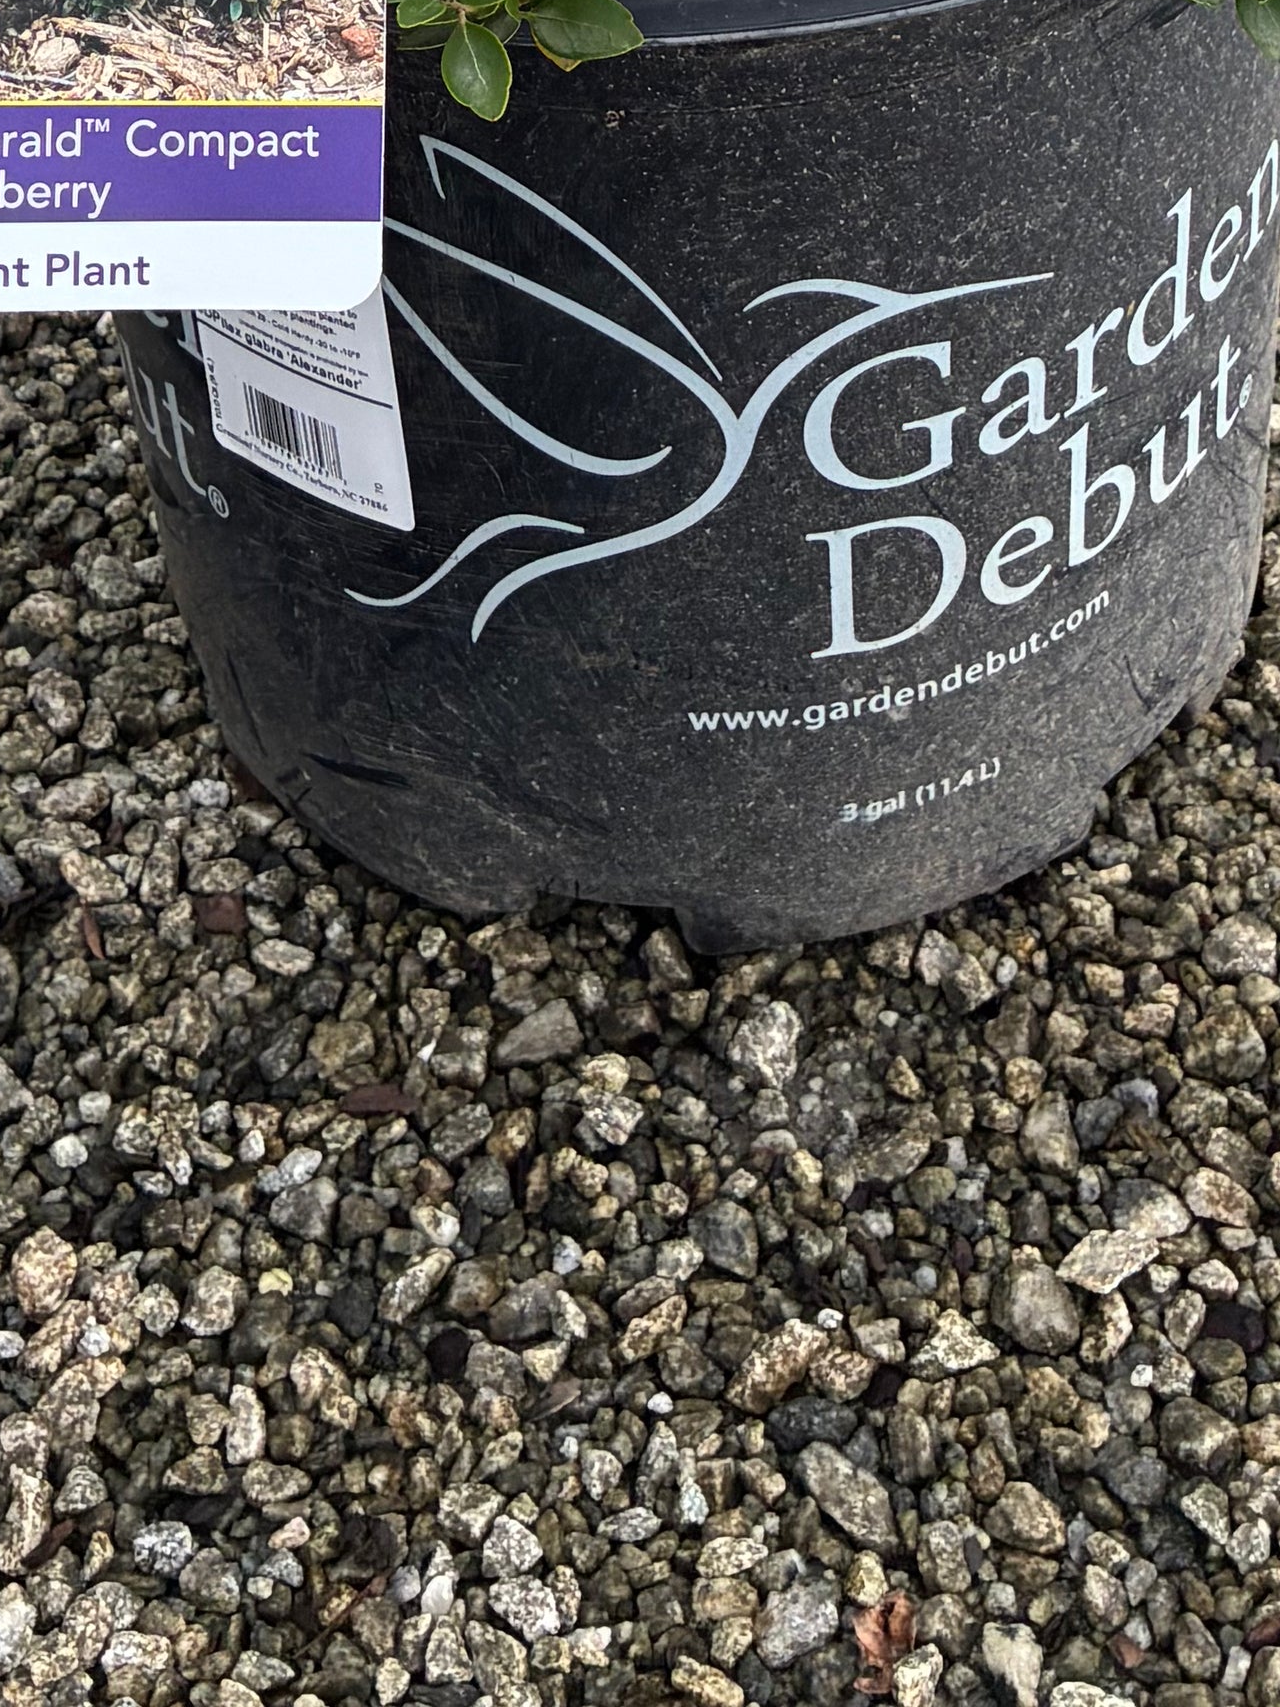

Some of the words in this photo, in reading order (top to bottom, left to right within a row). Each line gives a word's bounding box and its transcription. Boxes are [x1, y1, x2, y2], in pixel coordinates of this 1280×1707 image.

[125, 118, 322, 169] Compact
[45, 250, 152, 288] Plant
[803, 139, 1280, 491] Garden
[686, 588, 1111, 731] www.gardendebut.com
[839, 802, 859, 823] 3
[861, 790, 906, 823] gal
